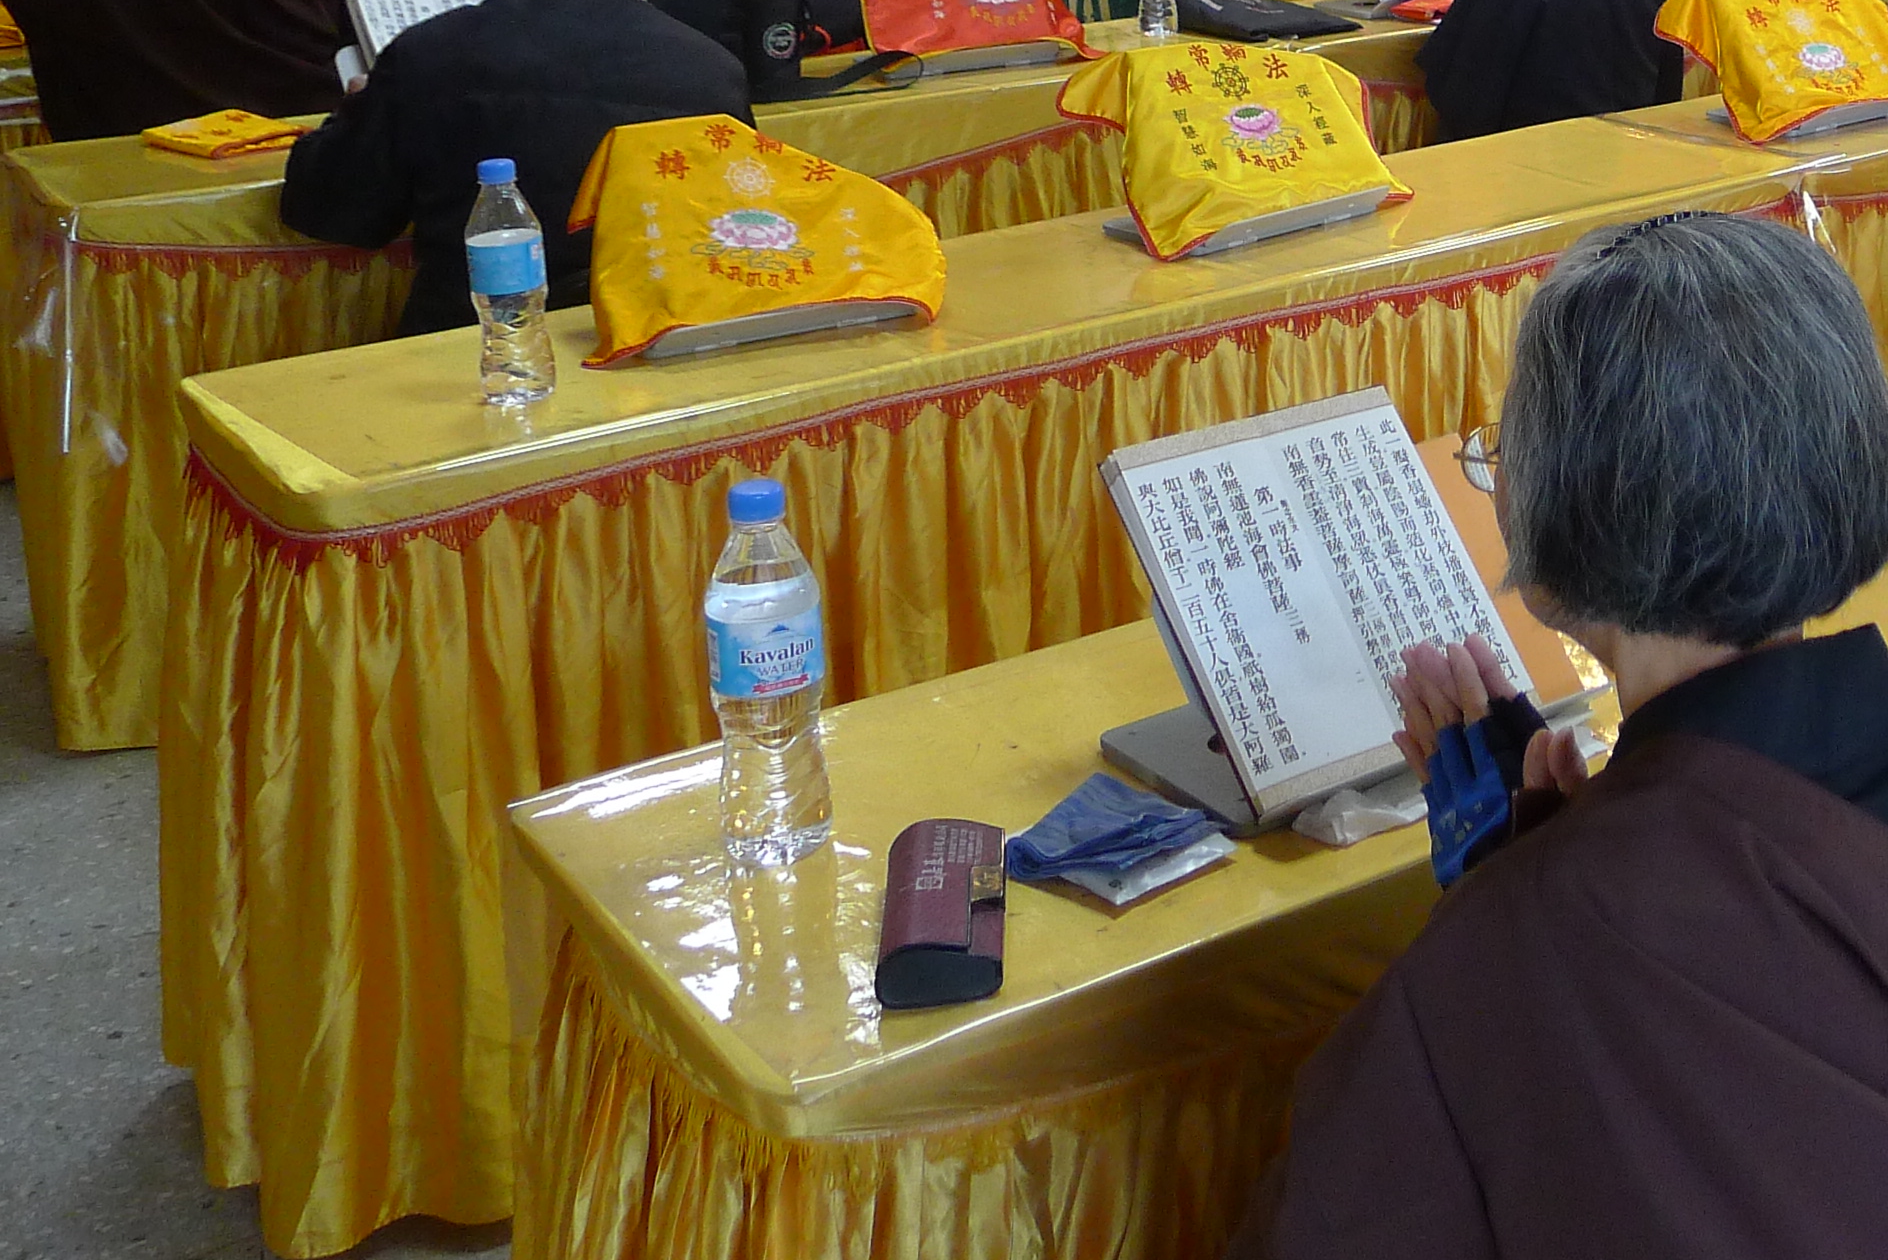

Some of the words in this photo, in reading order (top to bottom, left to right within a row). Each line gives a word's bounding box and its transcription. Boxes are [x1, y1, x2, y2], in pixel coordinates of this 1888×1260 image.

[1165, 44, 1289, 97] 法輪常轉
[1172, 108, 1219, 173] 智慧如海
[1295, 83, 1338, 146] 深入經藏
[655, 123, 837, 183] 法輪常轉
[1184, 466, 1246, 570] 佛說阿彌陀經
[1251, 485, 1306, 573] 第一時法事
[739, 637, 815, 665] Kavalan
[757, 656, 804, 677] WATER
